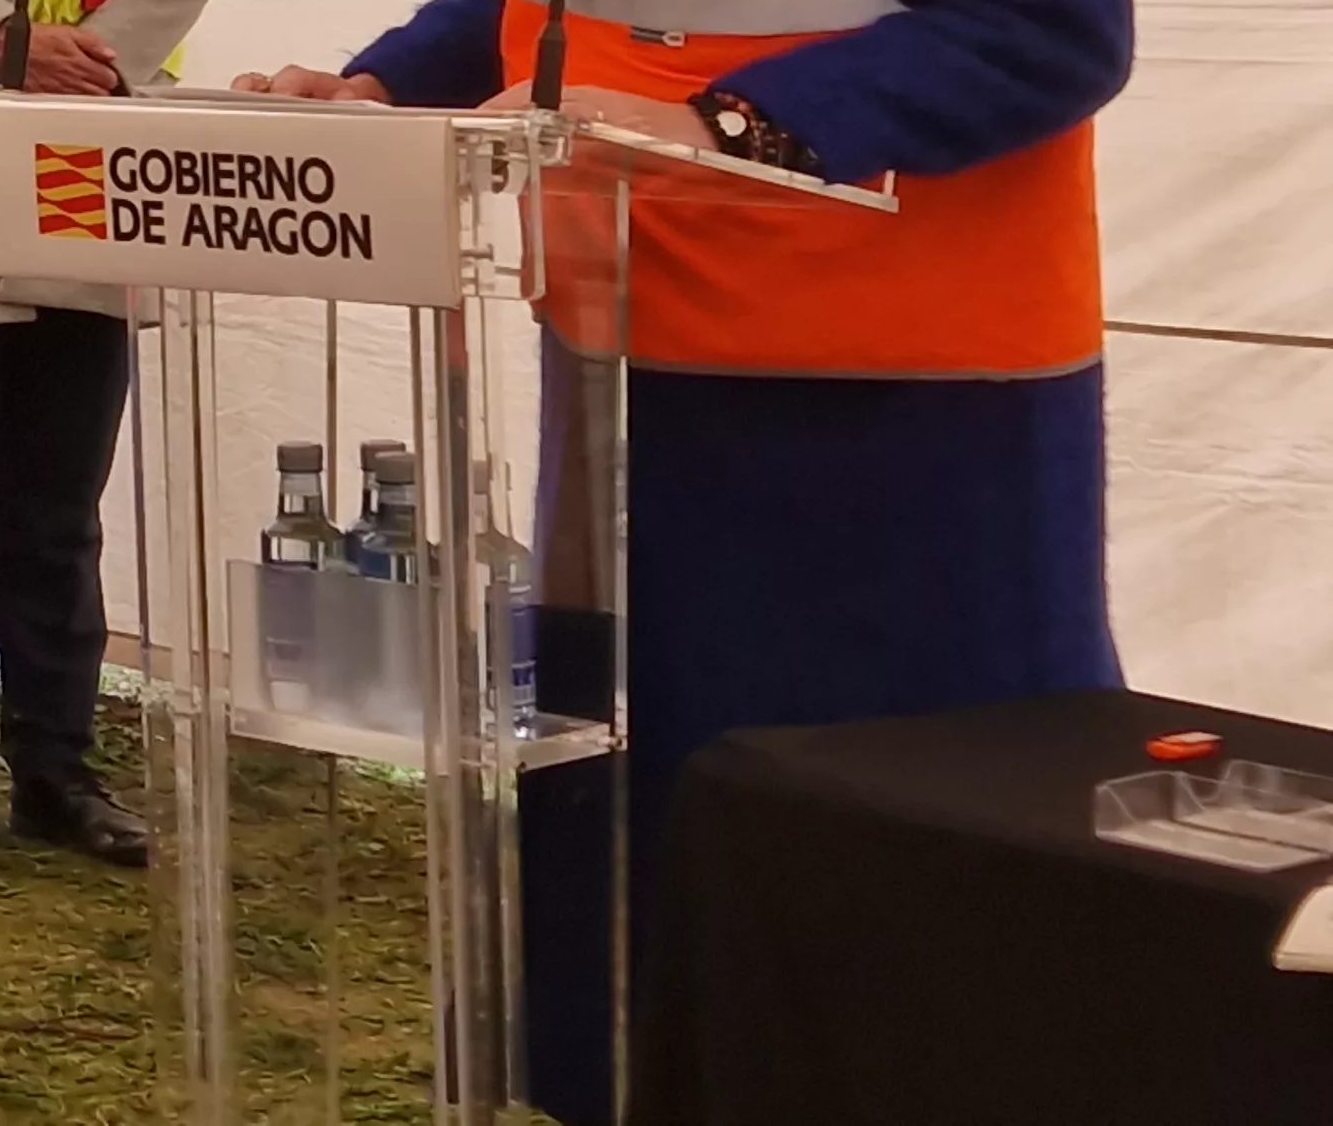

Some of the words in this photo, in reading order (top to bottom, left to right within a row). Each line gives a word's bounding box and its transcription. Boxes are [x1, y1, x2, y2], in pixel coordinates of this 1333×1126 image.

[109, 147, 335, 203] GOBIERNO
[111, 198, 166, 245] DE
[182, 203, 373, 260] ARAGON
